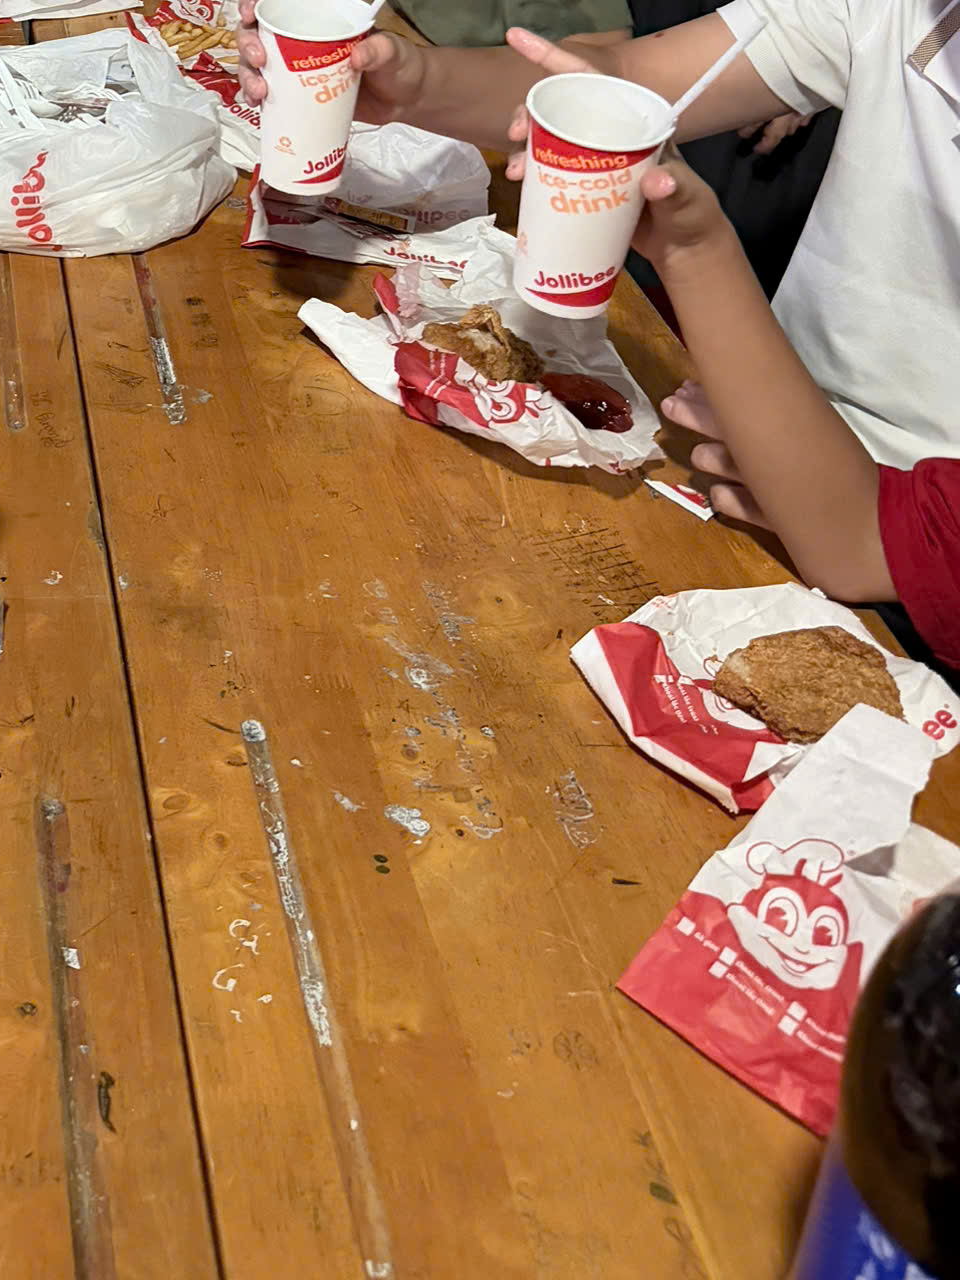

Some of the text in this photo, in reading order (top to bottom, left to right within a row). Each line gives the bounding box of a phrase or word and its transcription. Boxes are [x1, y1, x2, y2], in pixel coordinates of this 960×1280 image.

[304, 144, 347, 175] Jollib
[535, 147, 629, 170] refreshing
[537, 166, 633, 191] ice-cold
[549, 190, 630, 214] drink
[534, 266, 616, 289] Jollibee
